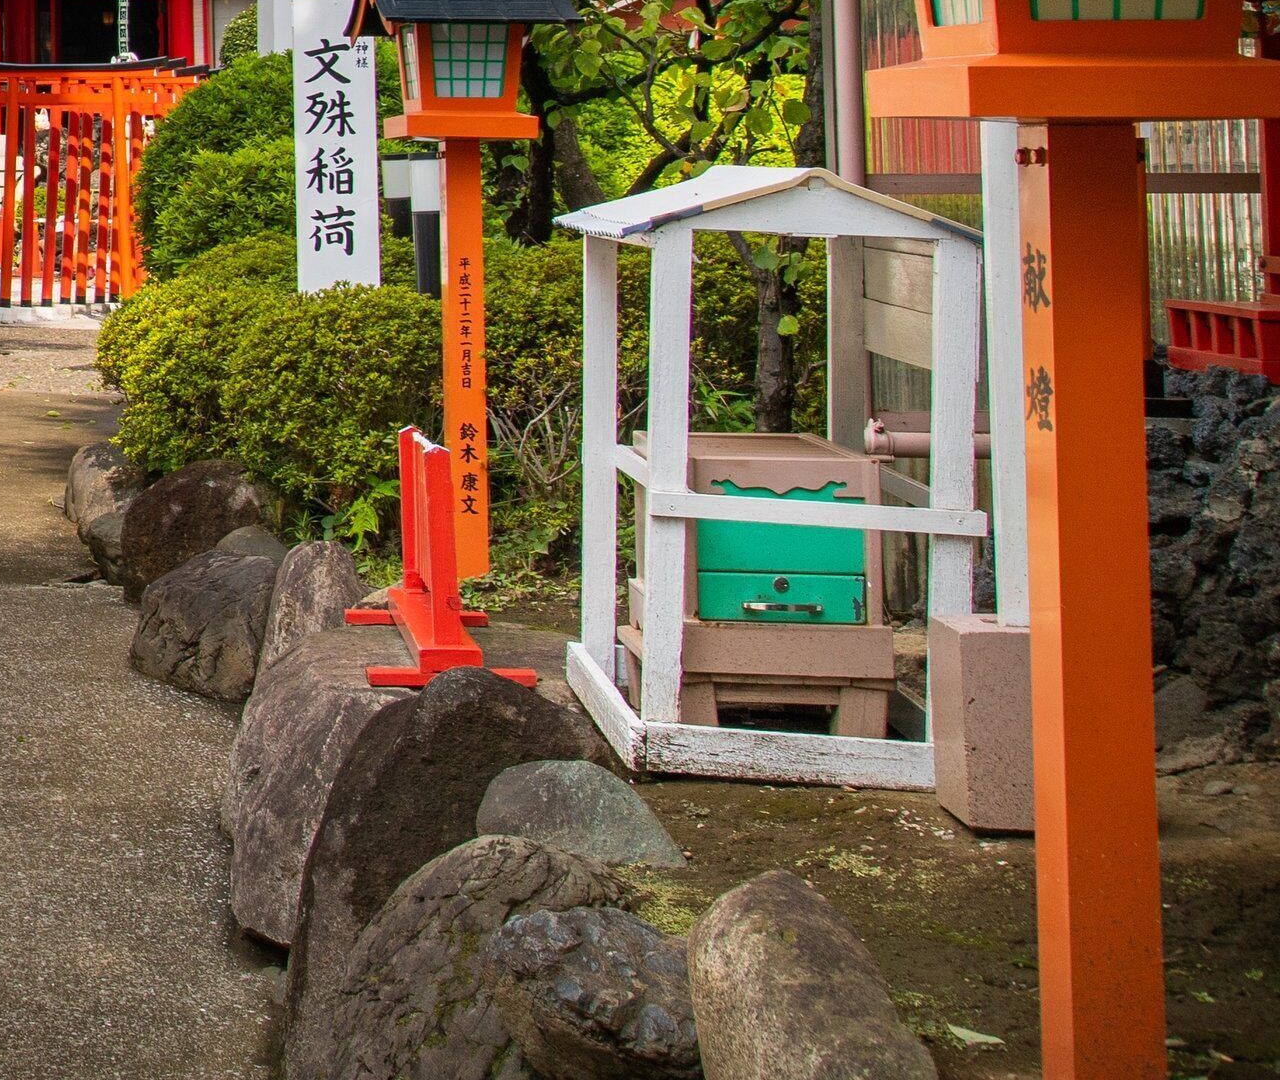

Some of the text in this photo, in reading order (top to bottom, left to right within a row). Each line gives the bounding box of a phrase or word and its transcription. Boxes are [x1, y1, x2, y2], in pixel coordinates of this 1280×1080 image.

[304, 38, 356, 256] 文殊稲荷
[458, 257, 473, 389] 平成二十二年一月吉日
